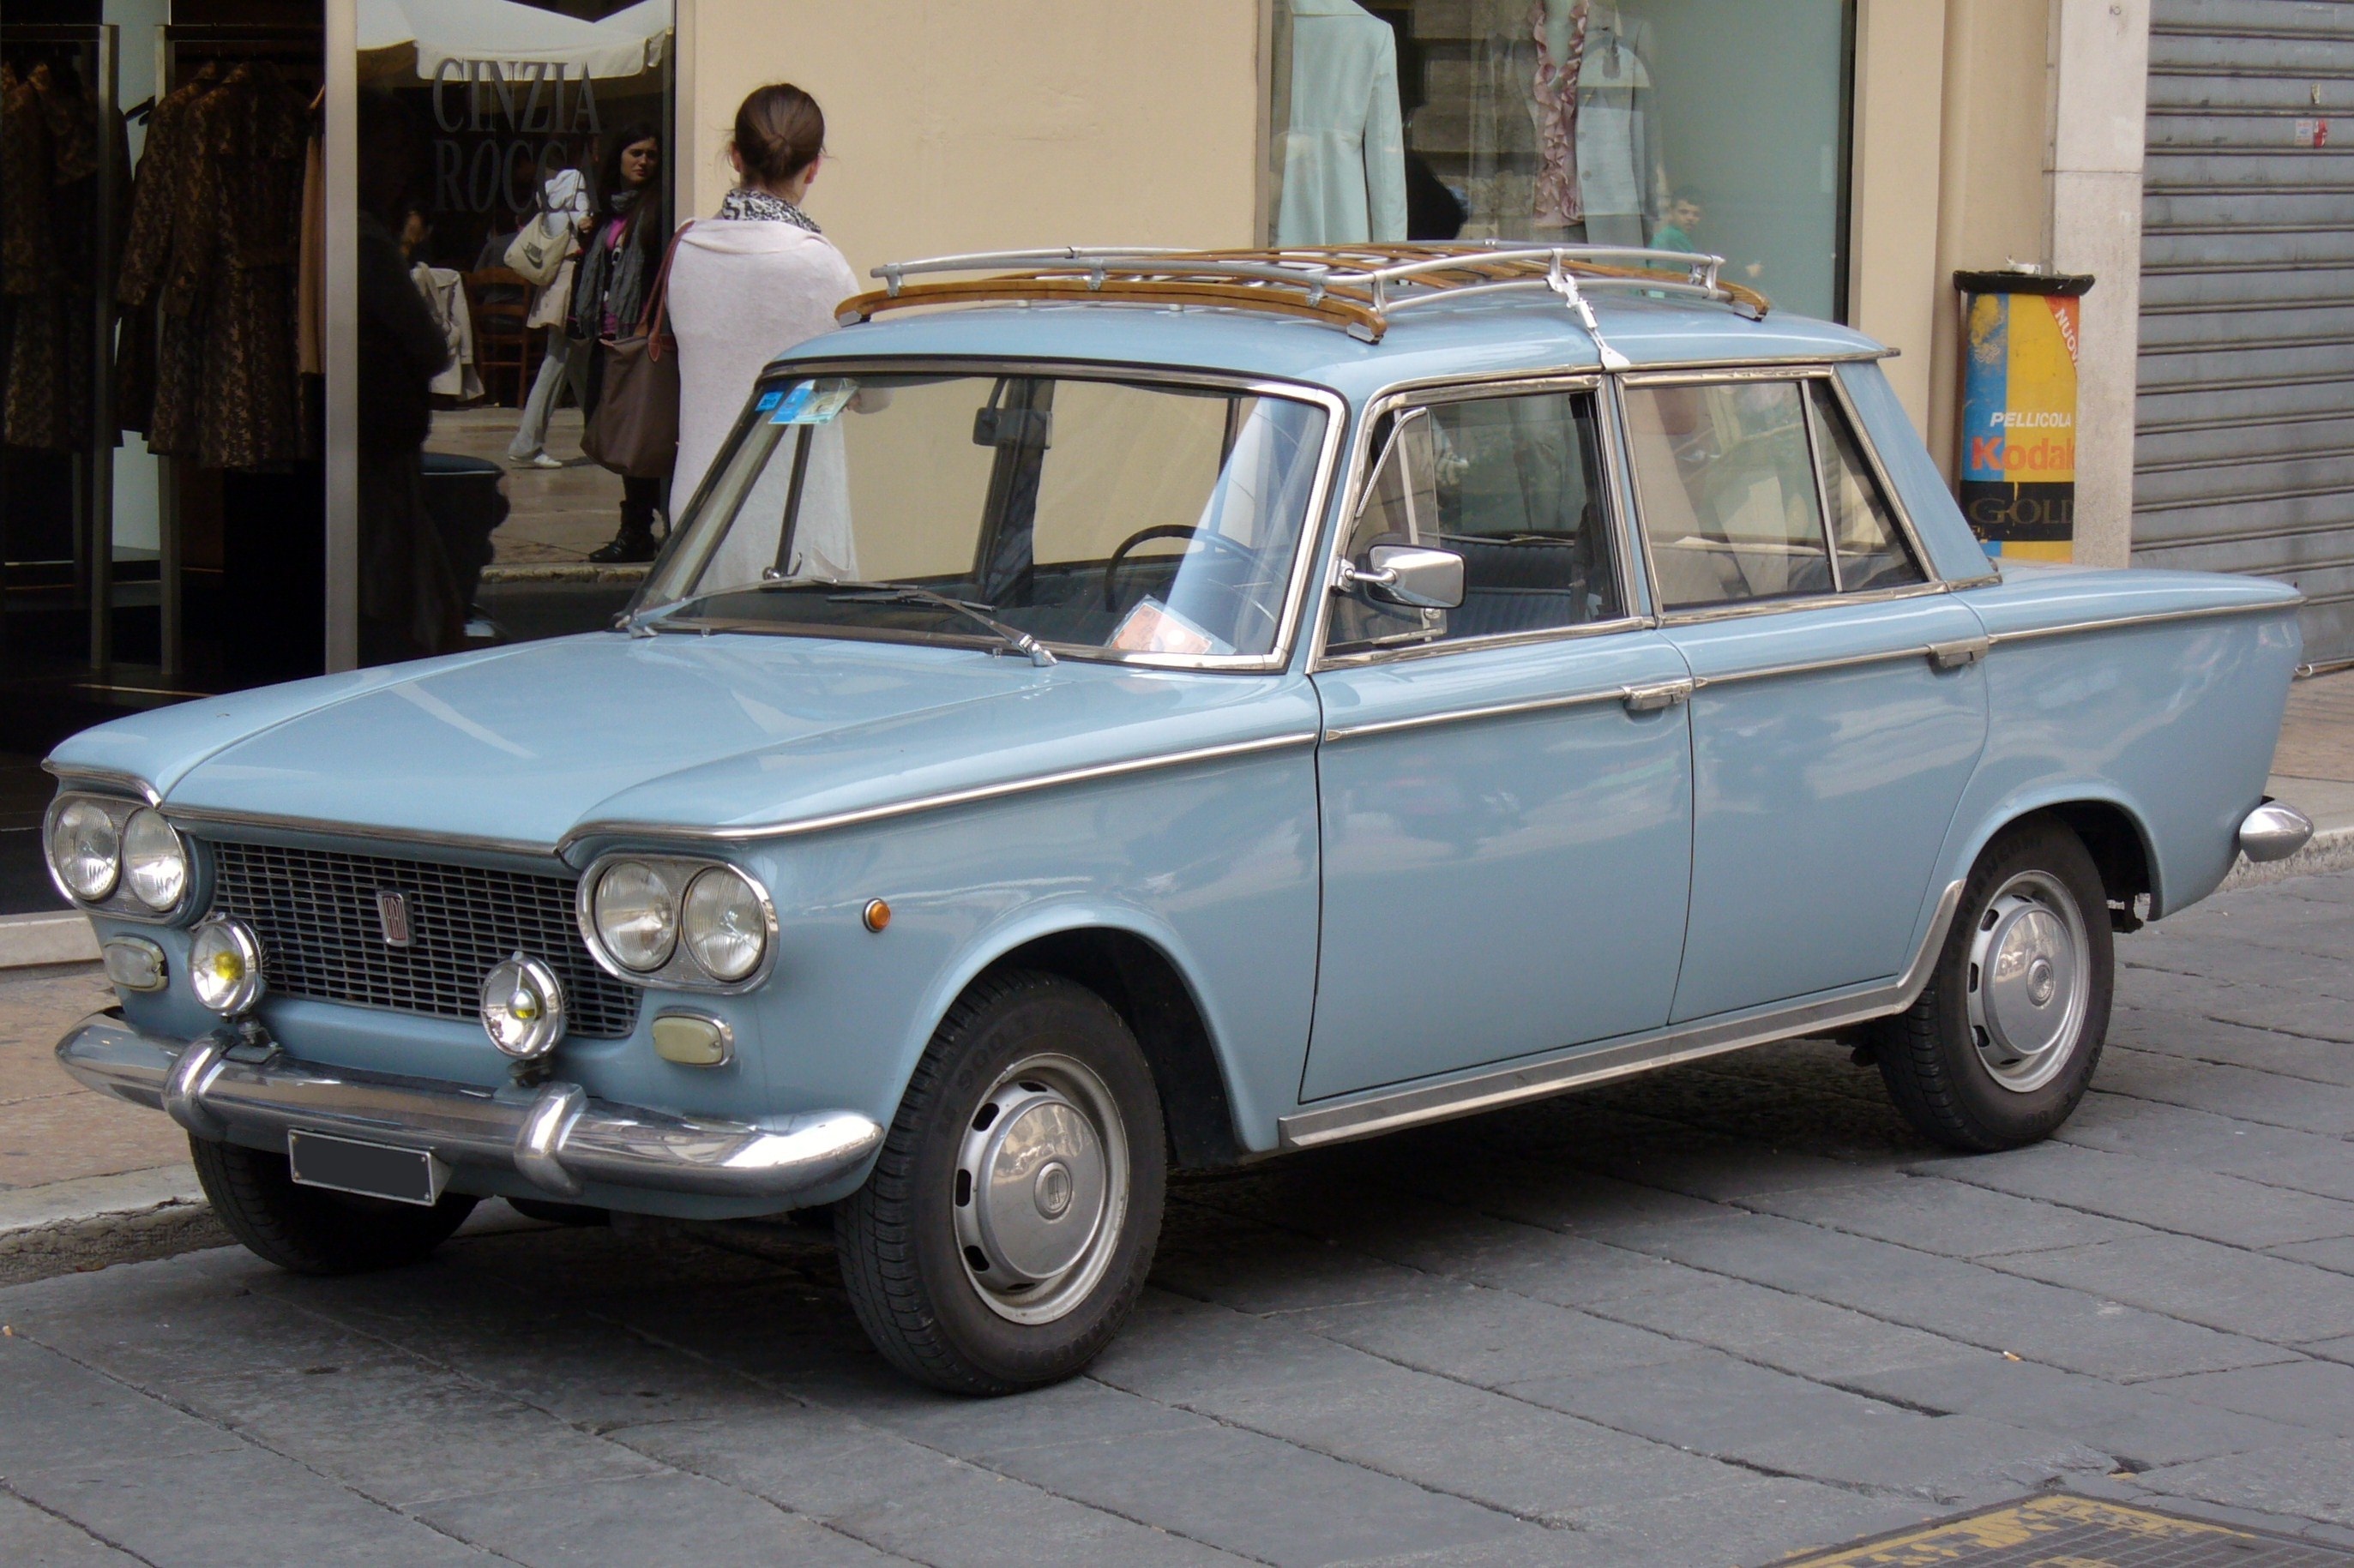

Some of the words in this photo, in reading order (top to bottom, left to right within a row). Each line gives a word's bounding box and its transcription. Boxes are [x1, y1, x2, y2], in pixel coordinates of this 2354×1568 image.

[432, 57, 602, 134] CINZIA
[433, 139, 602, 213] ROCCA
[1990, 412, 2072, 428] PELLICOLA
